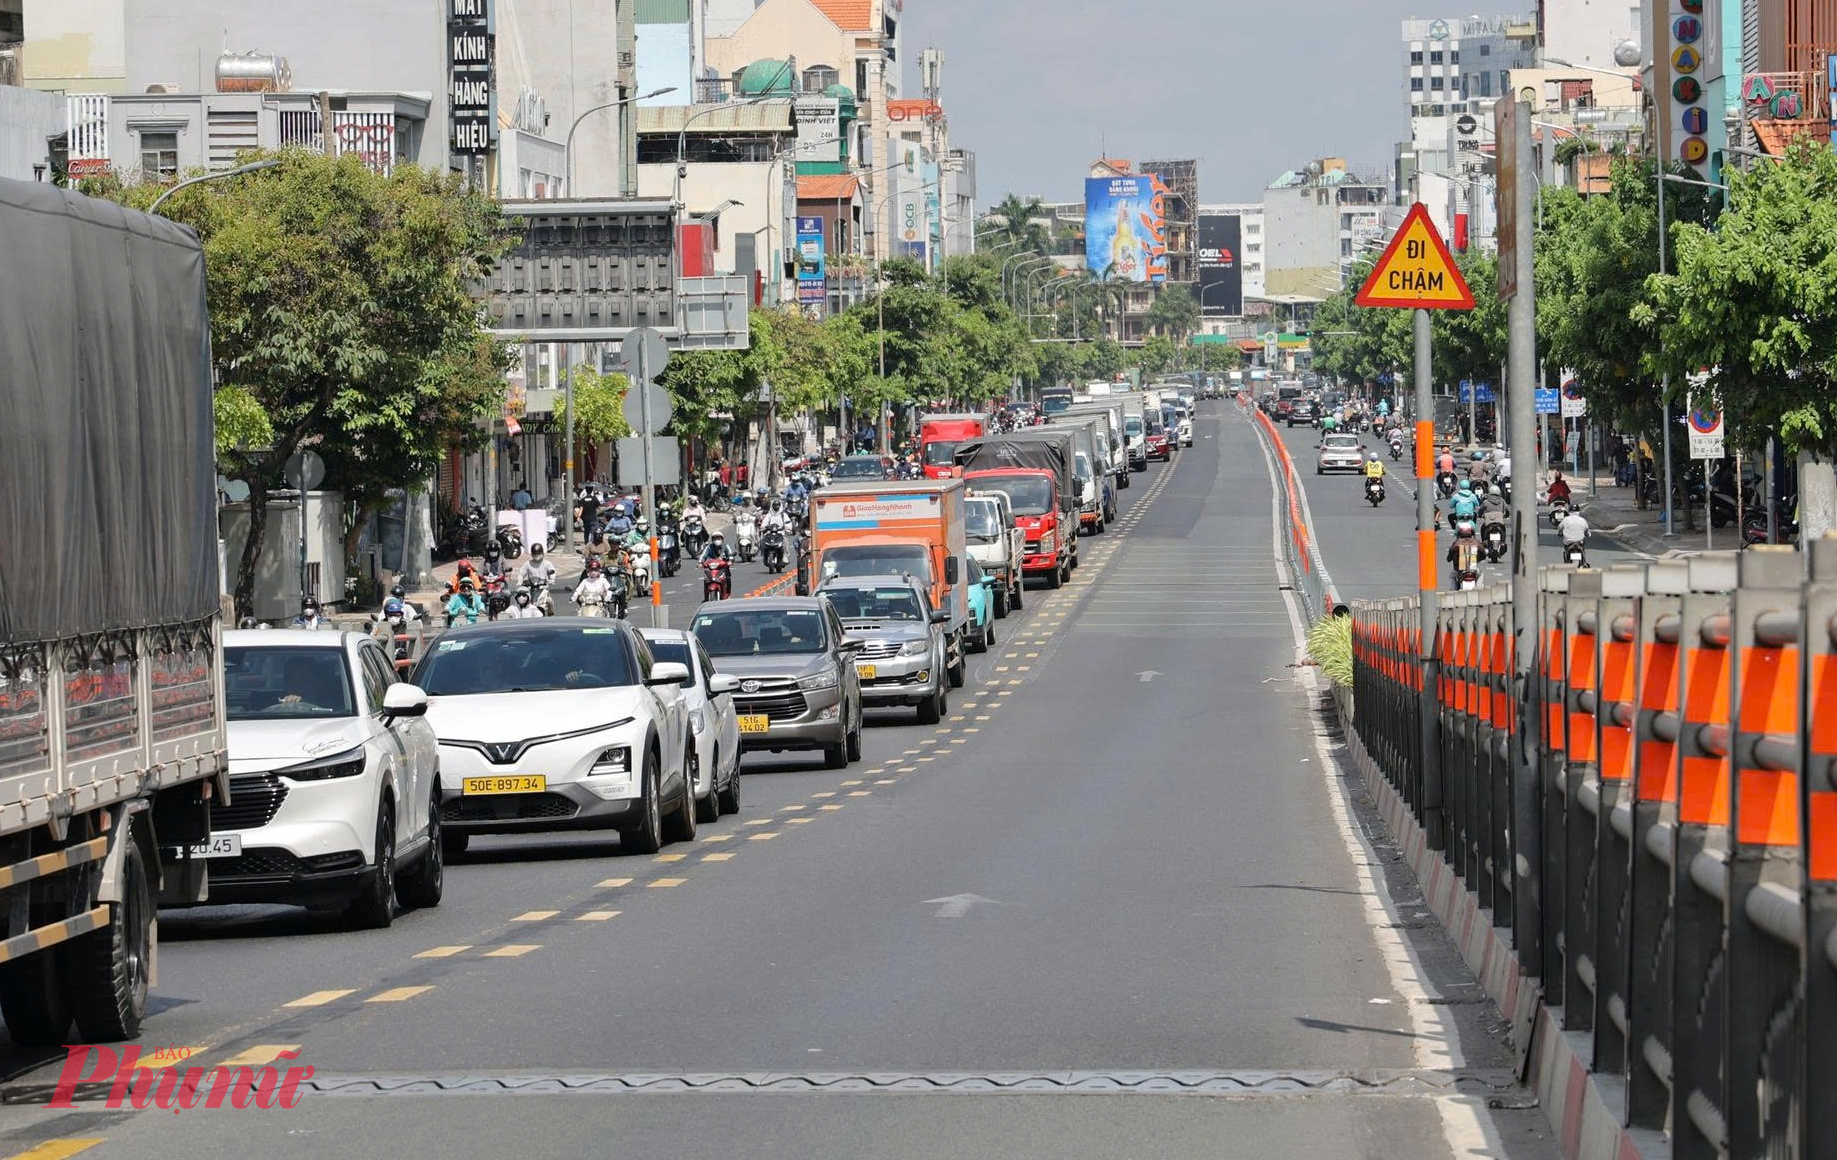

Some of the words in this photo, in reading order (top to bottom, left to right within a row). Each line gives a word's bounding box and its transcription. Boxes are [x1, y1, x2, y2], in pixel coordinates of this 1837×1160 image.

[453, 31, 486, 60] KÍNH
[454, 77, 488, 106] HÀNG
[456, 120, 488, 153] HIỆU
[1406, 240, 1425, 260] ĐI
[743, 716, 759, 724] 51G
